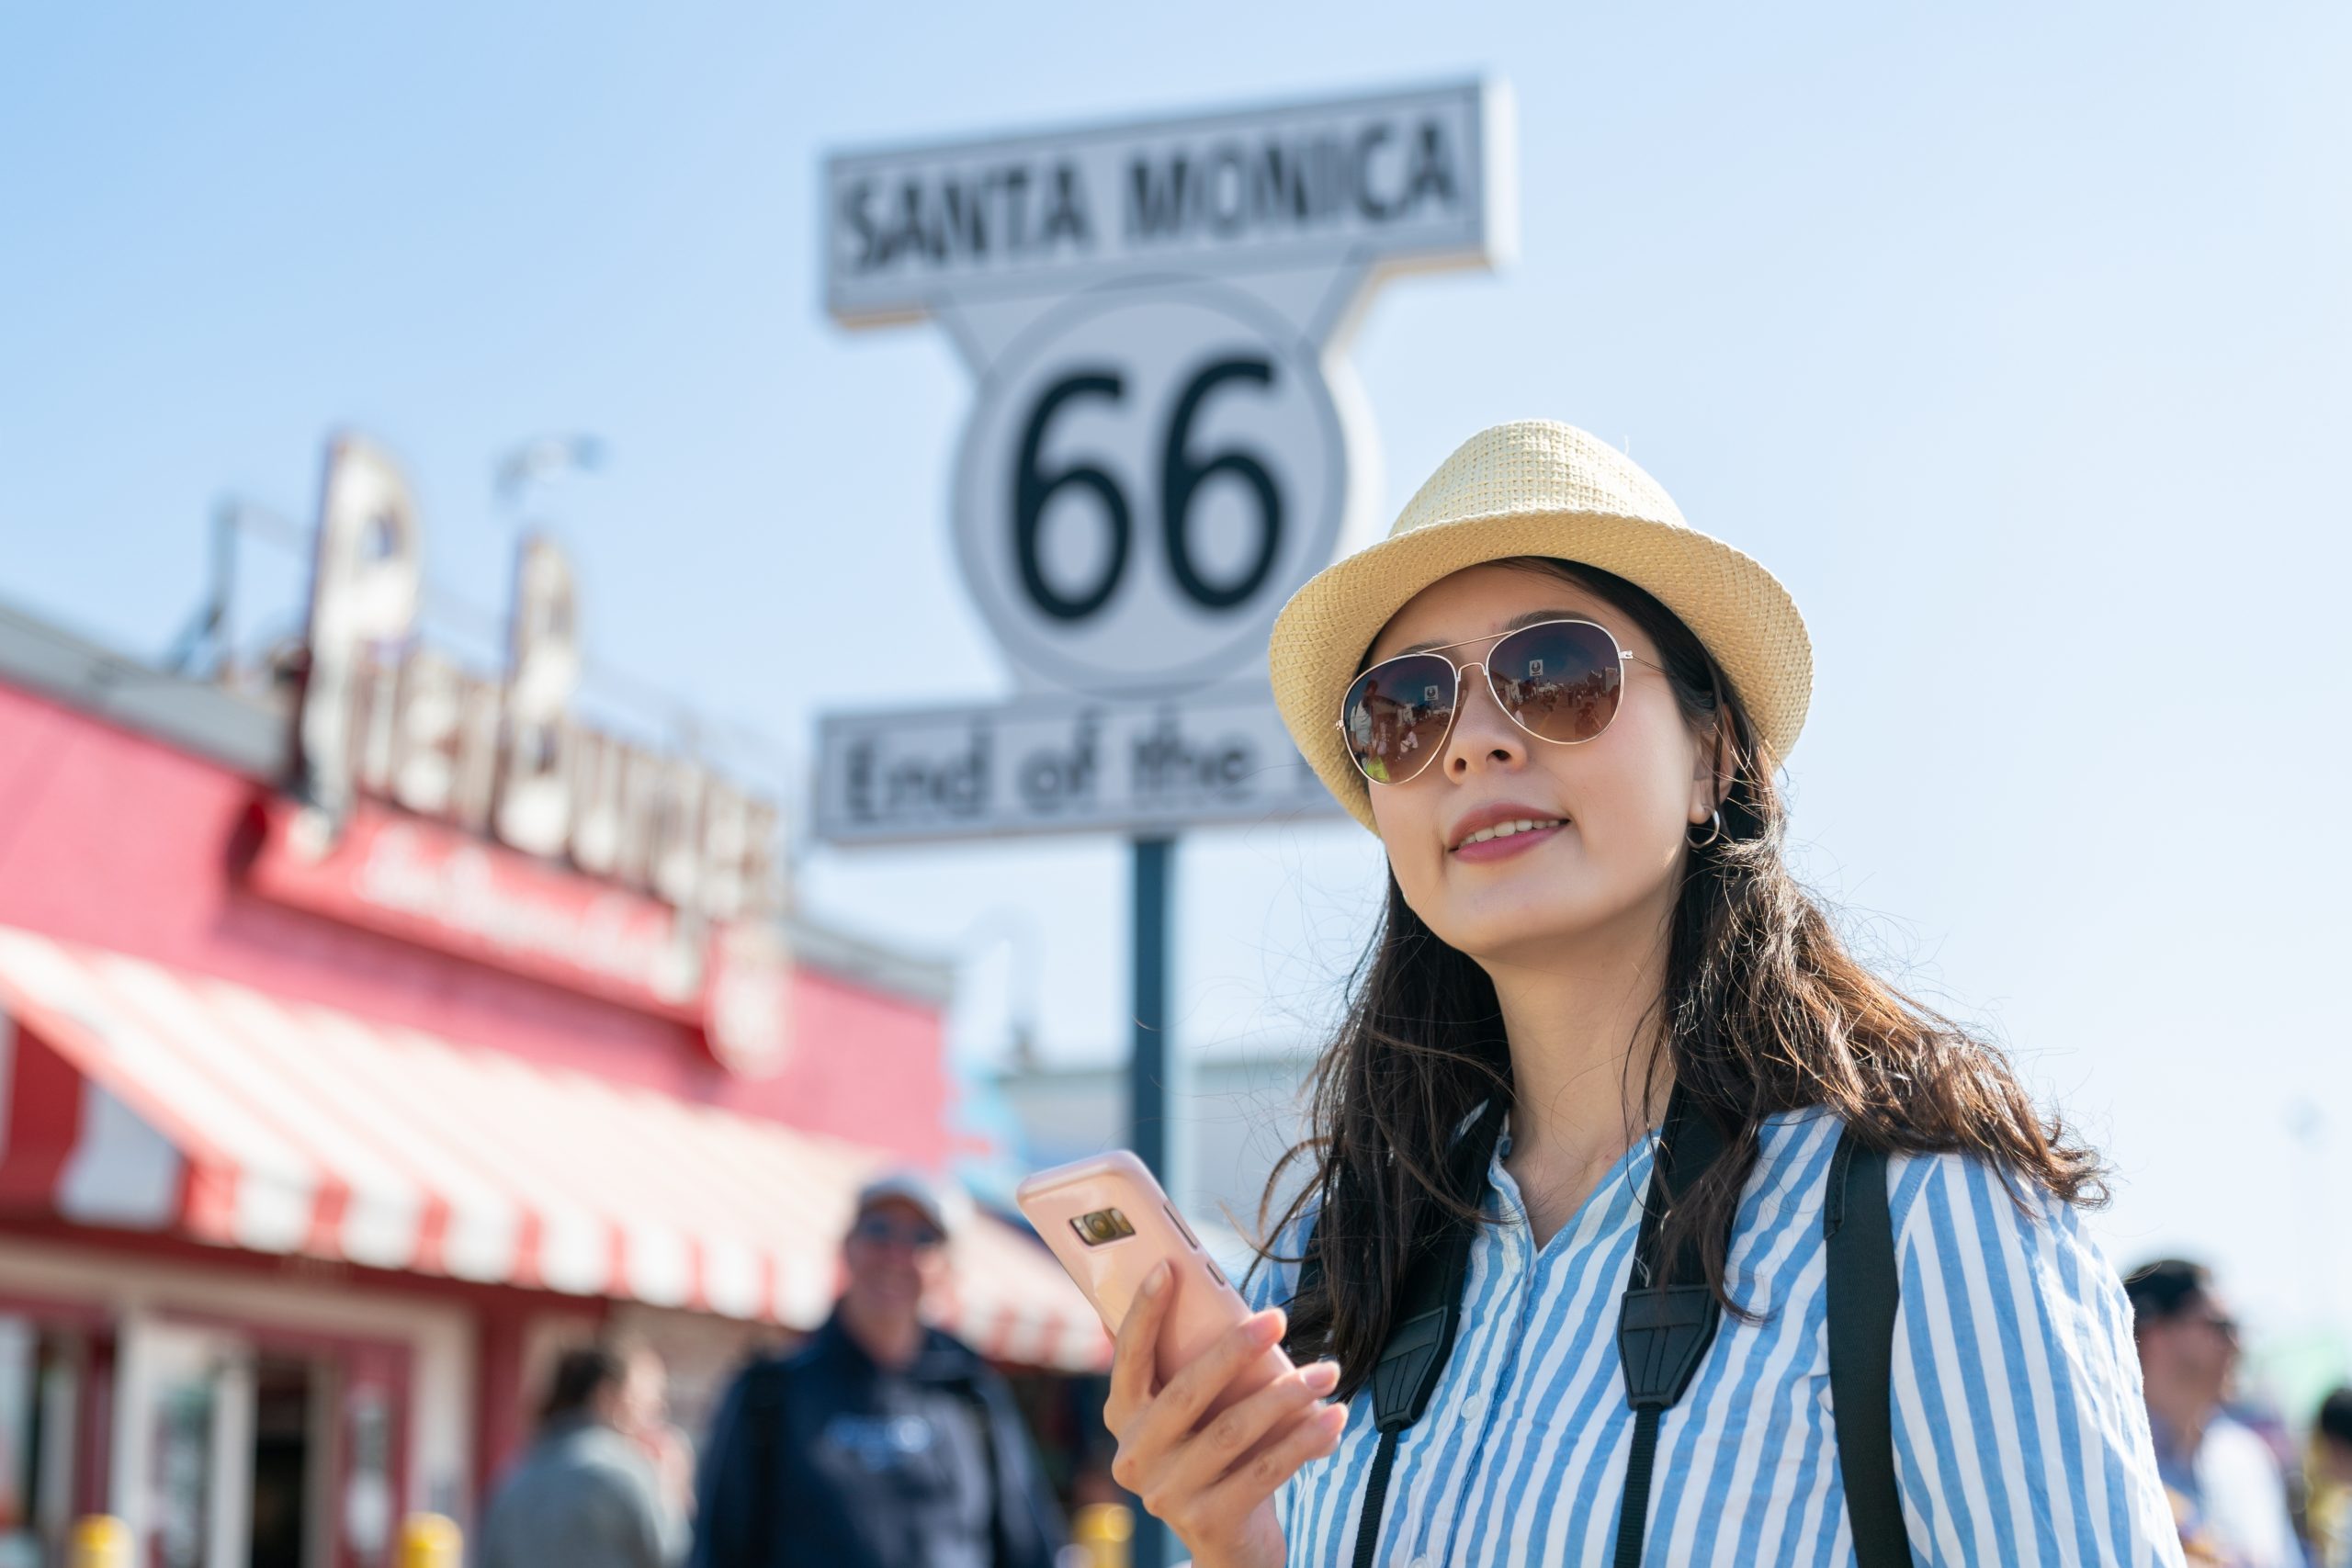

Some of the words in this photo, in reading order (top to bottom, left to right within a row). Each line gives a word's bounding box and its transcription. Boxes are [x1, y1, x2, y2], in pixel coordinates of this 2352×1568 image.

[842, 156, 1091, 274] SANTA
[1123, 114, 1459, 243] MONICA
[1012, 355, 1283, 623] 66
[843, 715, 994, 820] End
[1022, 707, 1102, 812] of
[1130, 702, 1251, 808] the
